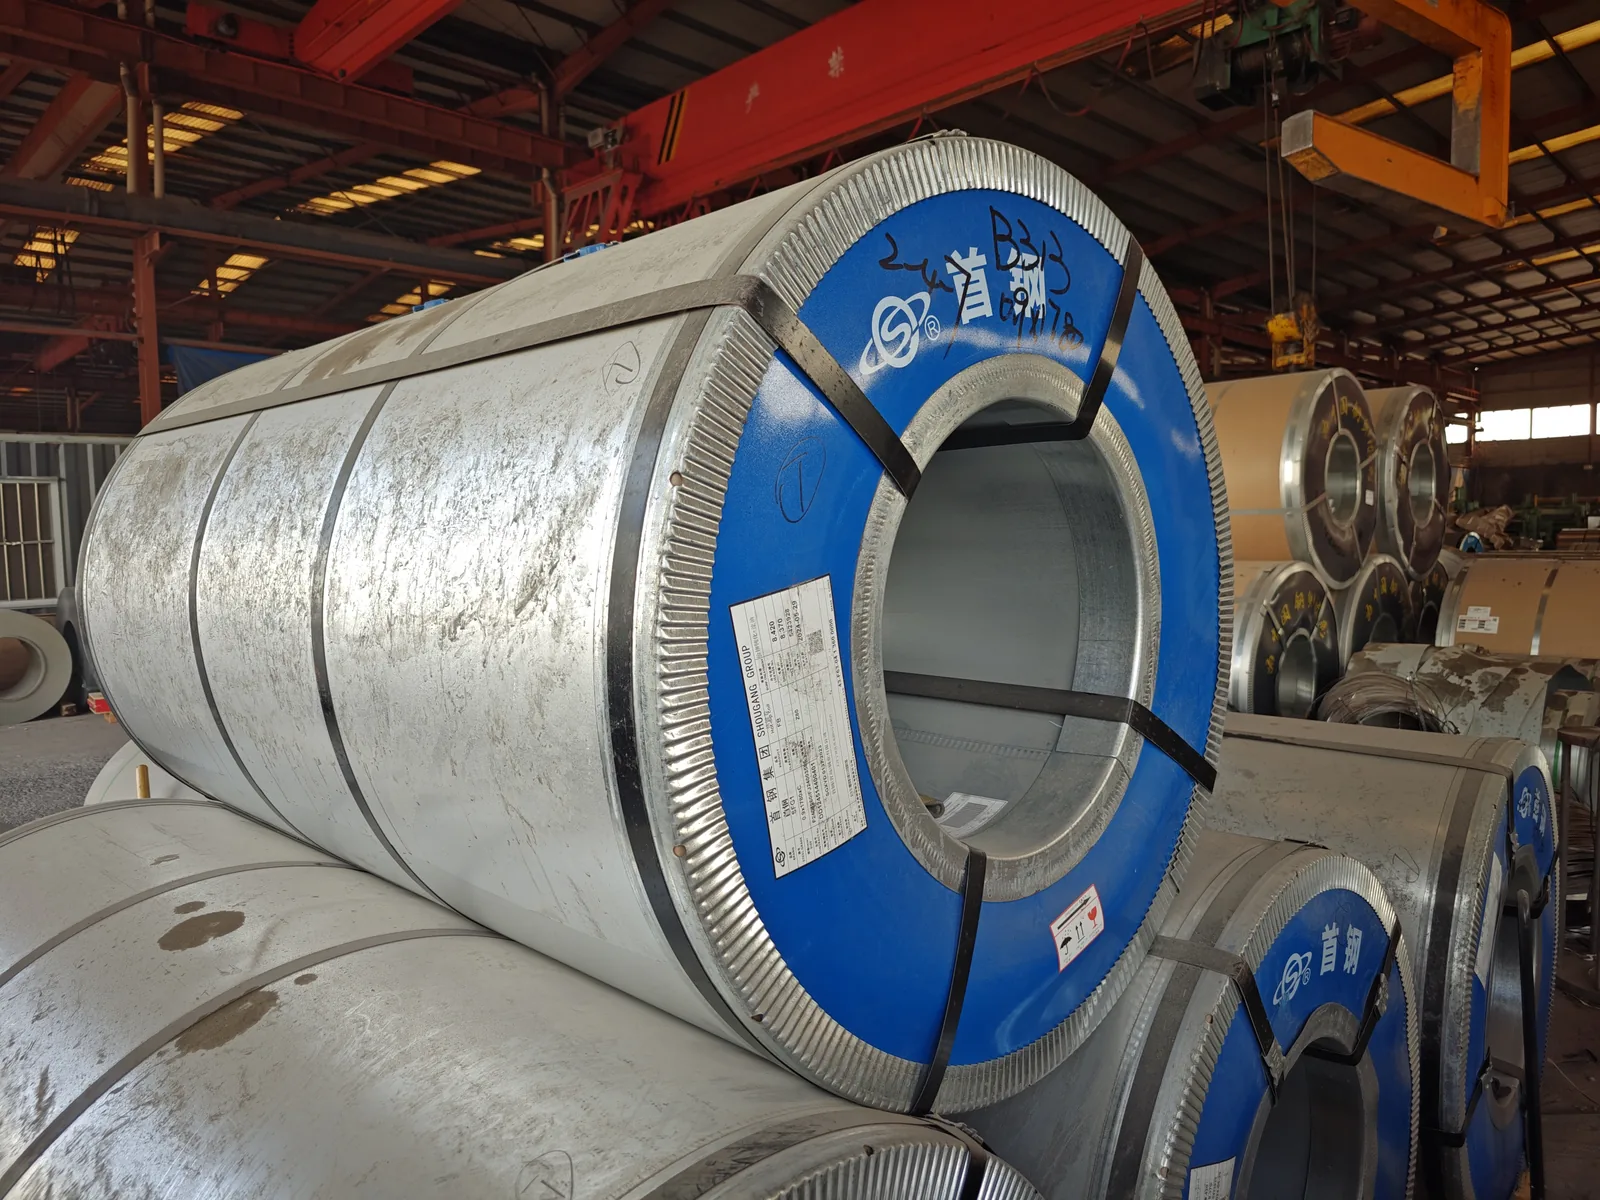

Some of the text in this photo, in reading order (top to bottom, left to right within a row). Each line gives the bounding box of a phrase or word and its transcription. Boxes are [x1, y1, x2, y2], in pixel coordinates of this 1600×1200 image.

[769, 621, 777, 642] 8.420
[777, 618, 785, 639] 8.370
[792, 601, 803, 642] 2024-05-29
[741, 645, 780, 823] 首钢集团 SHOUGANG GROUP
[1320, 922, 1363, 976] 首钢
